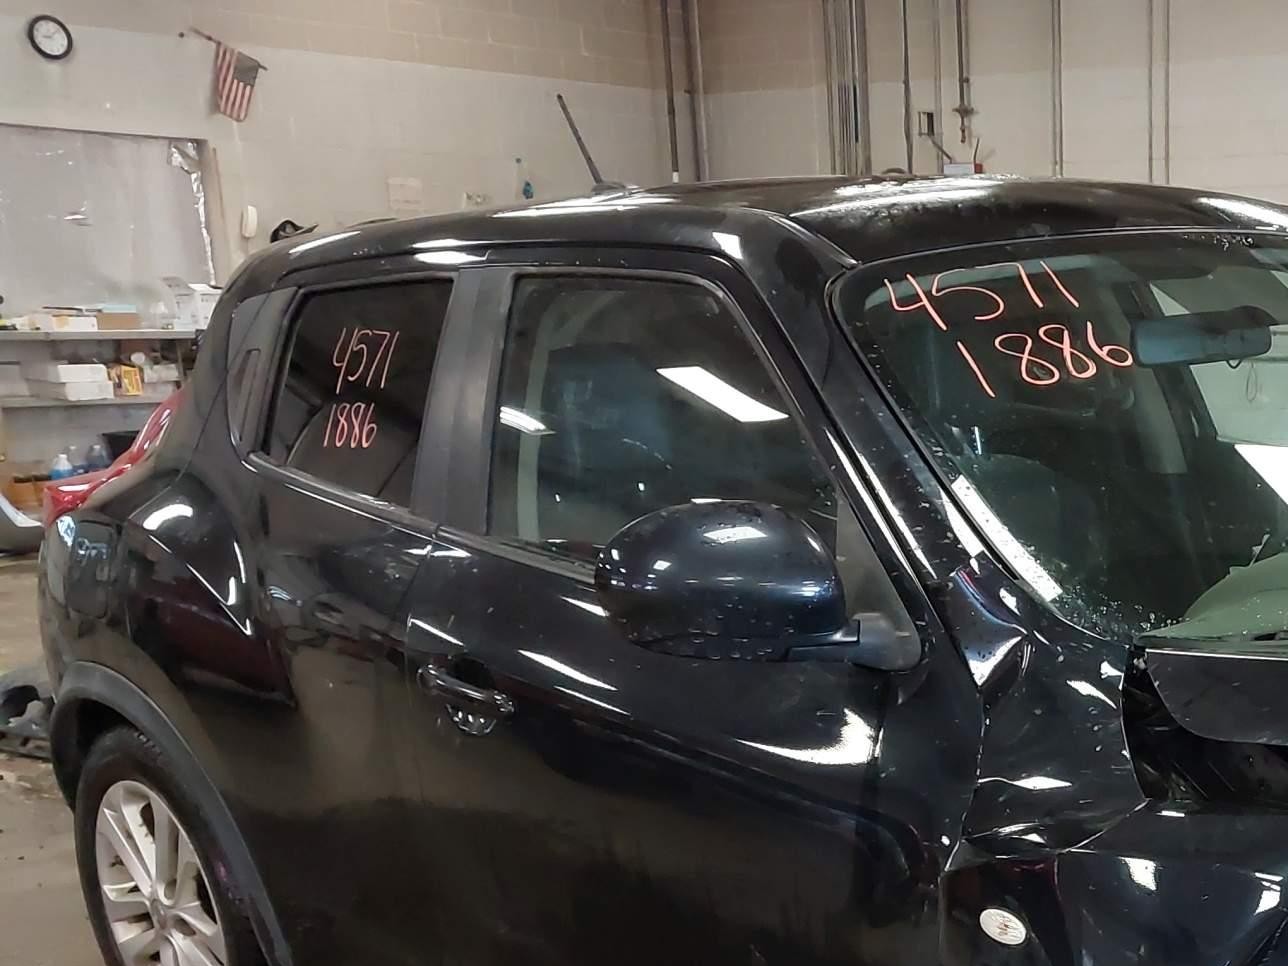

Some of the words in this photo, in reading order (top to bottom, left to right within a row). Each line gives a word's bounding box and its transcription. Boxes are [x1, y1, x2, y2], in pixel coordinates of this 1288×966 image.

[332, 327, 400, 394] 4571
[956, 321, 1134, 398] 1886
[323, 402, 378, 449] 1886
